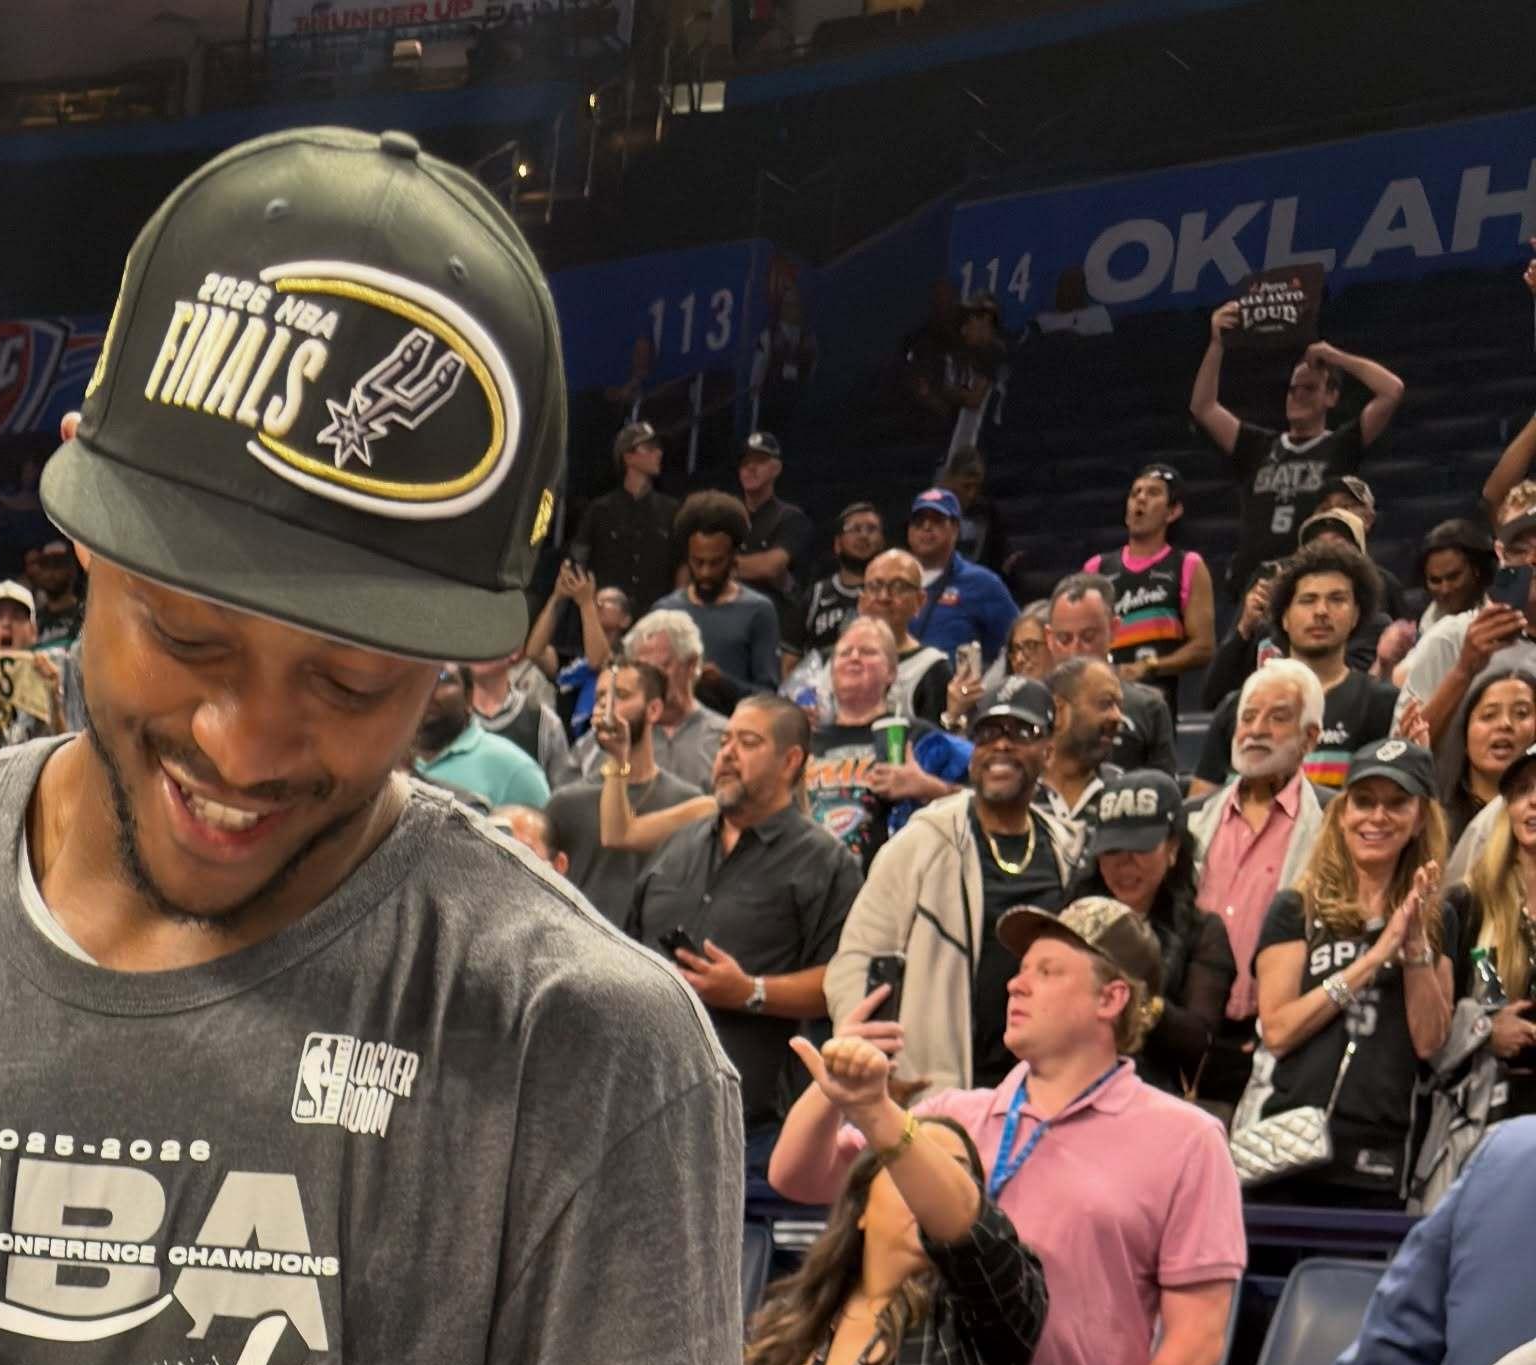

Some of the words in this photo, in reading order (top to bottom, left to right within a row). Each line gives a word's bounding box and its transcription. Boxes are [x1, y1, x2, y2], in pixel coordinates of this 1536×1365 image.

[197, 272, 274, 313] 2026
[274, 295, 341, 341] NBA
[959, 250, 1033, 308] 114
[647, 287, 735, 359] 113
[144, 299, 329, 437] FINALS
[1270, 504, 1296, 535] 5
[1100, 787, 1159, 823] SAS
[349, 1039, 420, 1098] LOCKER
[339, 1083, 395, 1139] ROOM
[168, 1246, 339, 1276] CHAMPIONS
